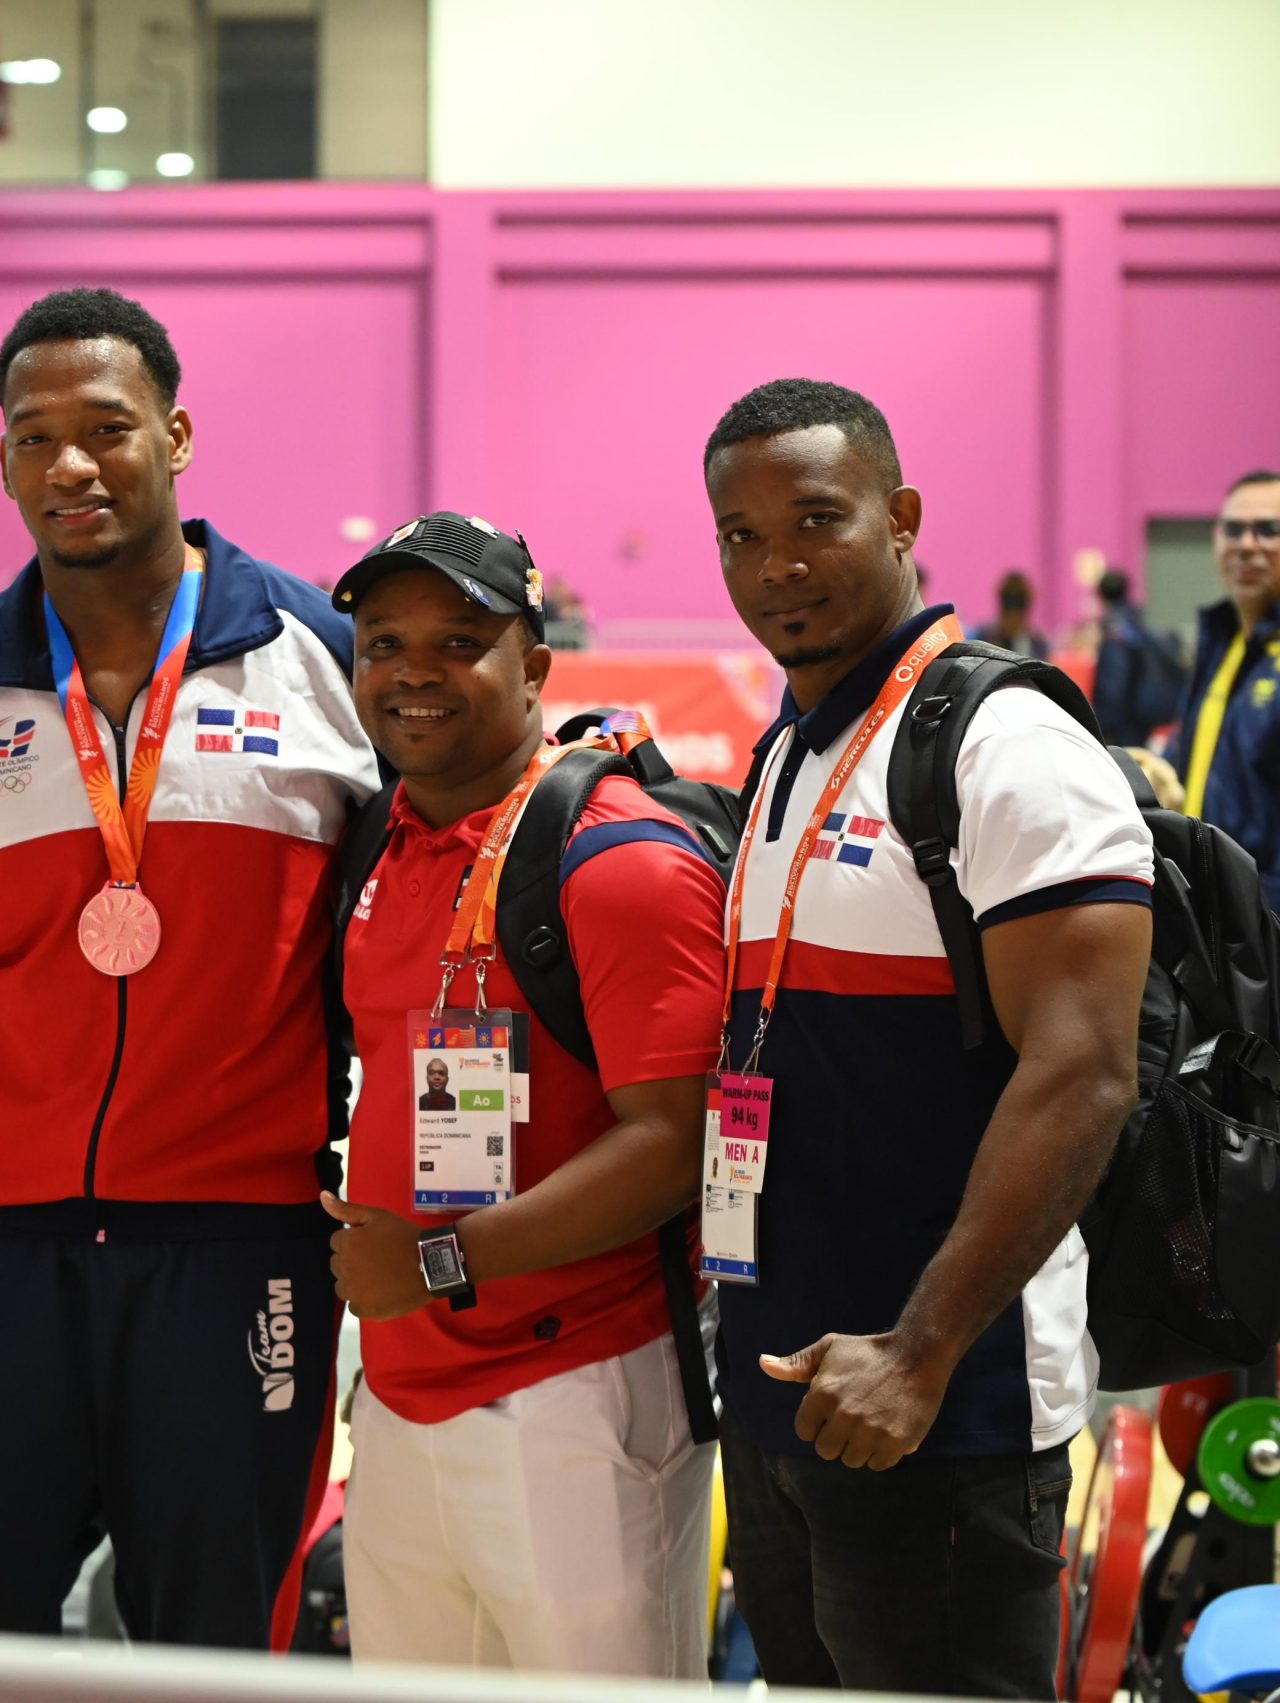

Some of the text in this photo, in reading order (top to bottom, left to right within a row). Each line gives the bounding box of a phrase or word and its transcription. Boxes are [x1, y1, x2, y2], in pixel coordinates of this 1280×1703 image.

[909, 629, 947, 666] quality
[839, 709, 885, 778] HERCULES
[473, 1095, 490, 1106] Ao
[723, 1088, 769, 1101] WARM-UP PASS
[732, 1106, 758, 1131] 94 kg
[725, 1142, 759, 1164] MEN A
[421, 1193, 492, 1203] A 2 R
[743, 1264, 748, 1274] R
[268, 1278, 295, 1369] DOM
